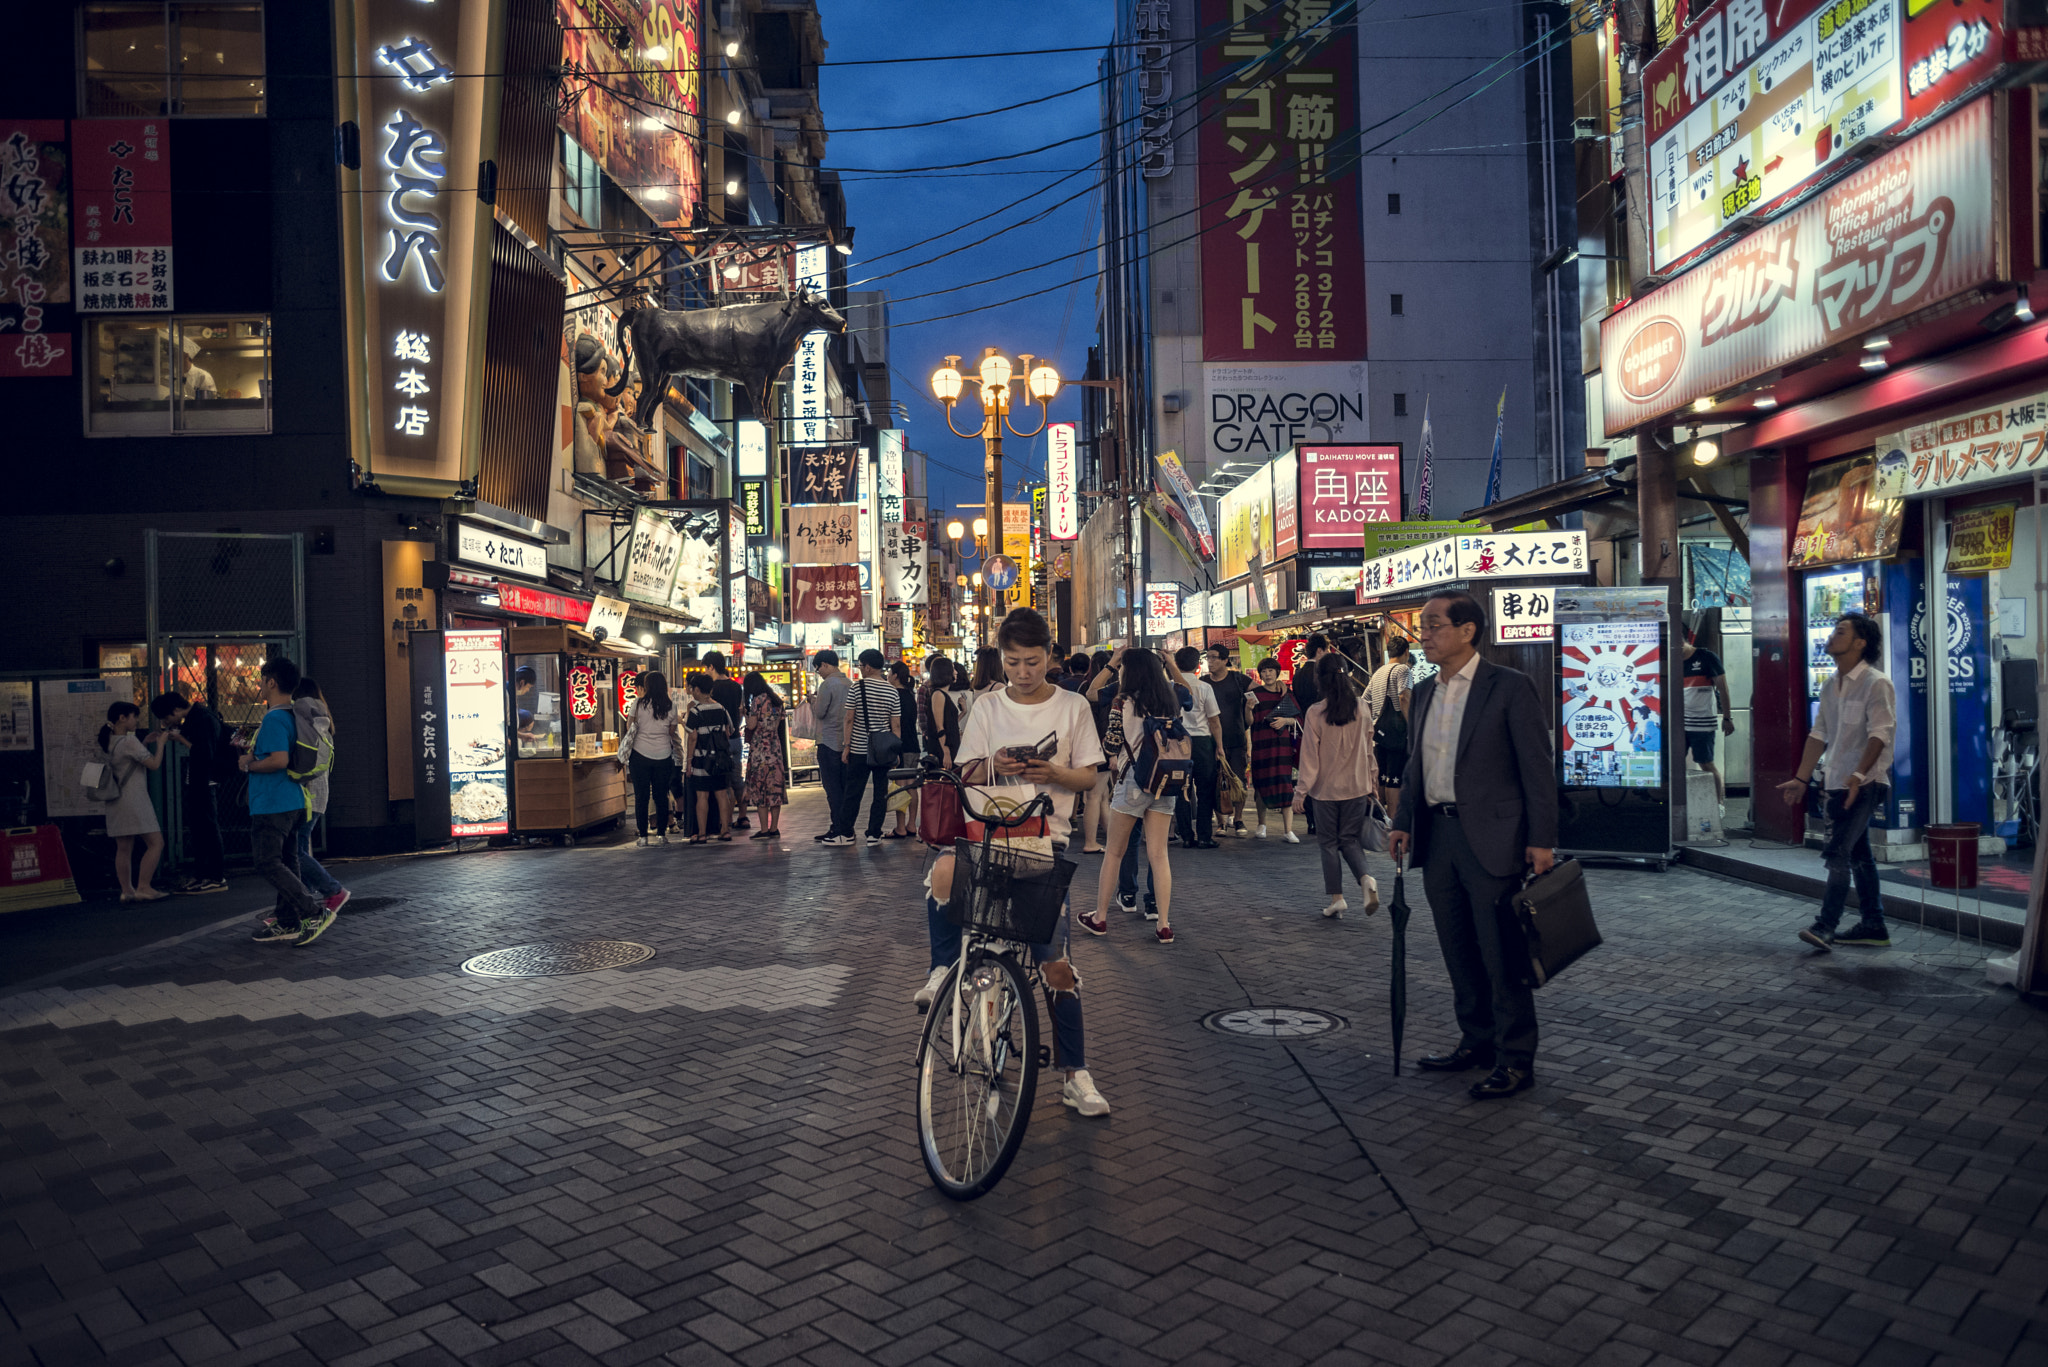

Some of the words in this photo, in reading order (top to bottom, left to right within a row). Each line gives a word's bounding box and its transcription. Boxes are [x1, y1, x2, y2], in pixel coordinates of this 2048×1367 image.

[1684, 0, 1786, 106] 相席
[1816, 3, 1891, 71] かに道楽本店
[1757, 36, 1804, 84] ビックカメラ
[1908, 20, 1990, 98] 徒歩2分
[1722, 79, 1747, 111] アムザ
[1771, 99, 1804, 128] くいだおれ
[1840, 97, 1875, 132] かに道楽
[1848, 123, 1866, 143] 本店
[1695, 121, 1739, 167] 千日前通り
[112, 165, 135, 225] たこ八
[1692, 170, 1714, 194] WINS
[1722, 175, 1762, 219] 現在地
[1828, 169, 1908, 225] Information
[1290, 194, 1311, 258] スロット
[1312, 192, 1334, 255] パチンコ
[1829, 213, 1870, 243] Office
[1872, 200, 1886, 218] in
[1834, 206, 1910, 259] Restaurant
[82, 249, 101, 310] 鉄板焼
[100, 250, 117, 310] ねぎ焼
[117, 249, 135, 310] 明石焼
[134, 249, 152, 310] たこ焼
[151, 249, 169, 310] お好み焼
[1294, 272, 1313, 350] 286台
[1316, 272, 1336, 350] 372台
[1623, 336, 1675, 374] GOURMET
[1637, 357, 1661, 386] MAP
[394, 329, 432, 436] 総本店
[1212, 393, 1362, 423] DRAGON
[1973, 413, 2001, 435] 飲食
[2005, 402, 2048, 429] 大阪ミ
[1213, 423, 1306, 453] GATE
[1942, 422, 1968, 445] 観光
[805, 452, 847, 467] 天ぷら
[1319, 453, 1353, 462] DAIHATSU
[1355, 453, 1376, 462] MOVE
[804, 468, 845, 498] 久幸
[1312, 467, 1390, 506] 角座
[1315, 508, 1391, 523] KADOZA
[887, 526, 898, 560] 道頓堀
[1461, 538, 1496, 551] 日本一
[1502, 541, 1570, 567] 大たこ
[816, 580, 857, 592] お好み焼
[900, 535, 922, 600] 串カツ
[1152, 591, 1175, 616] 薬
[1502, 592, 1549, 620] 串か
[769, 673, 783, 684] 2F
[1910, 656, 1974, 679] BSS
[571, 671, 591, 715] たこ焼
[1575, 723, 1609, 731] 徒歩2分
